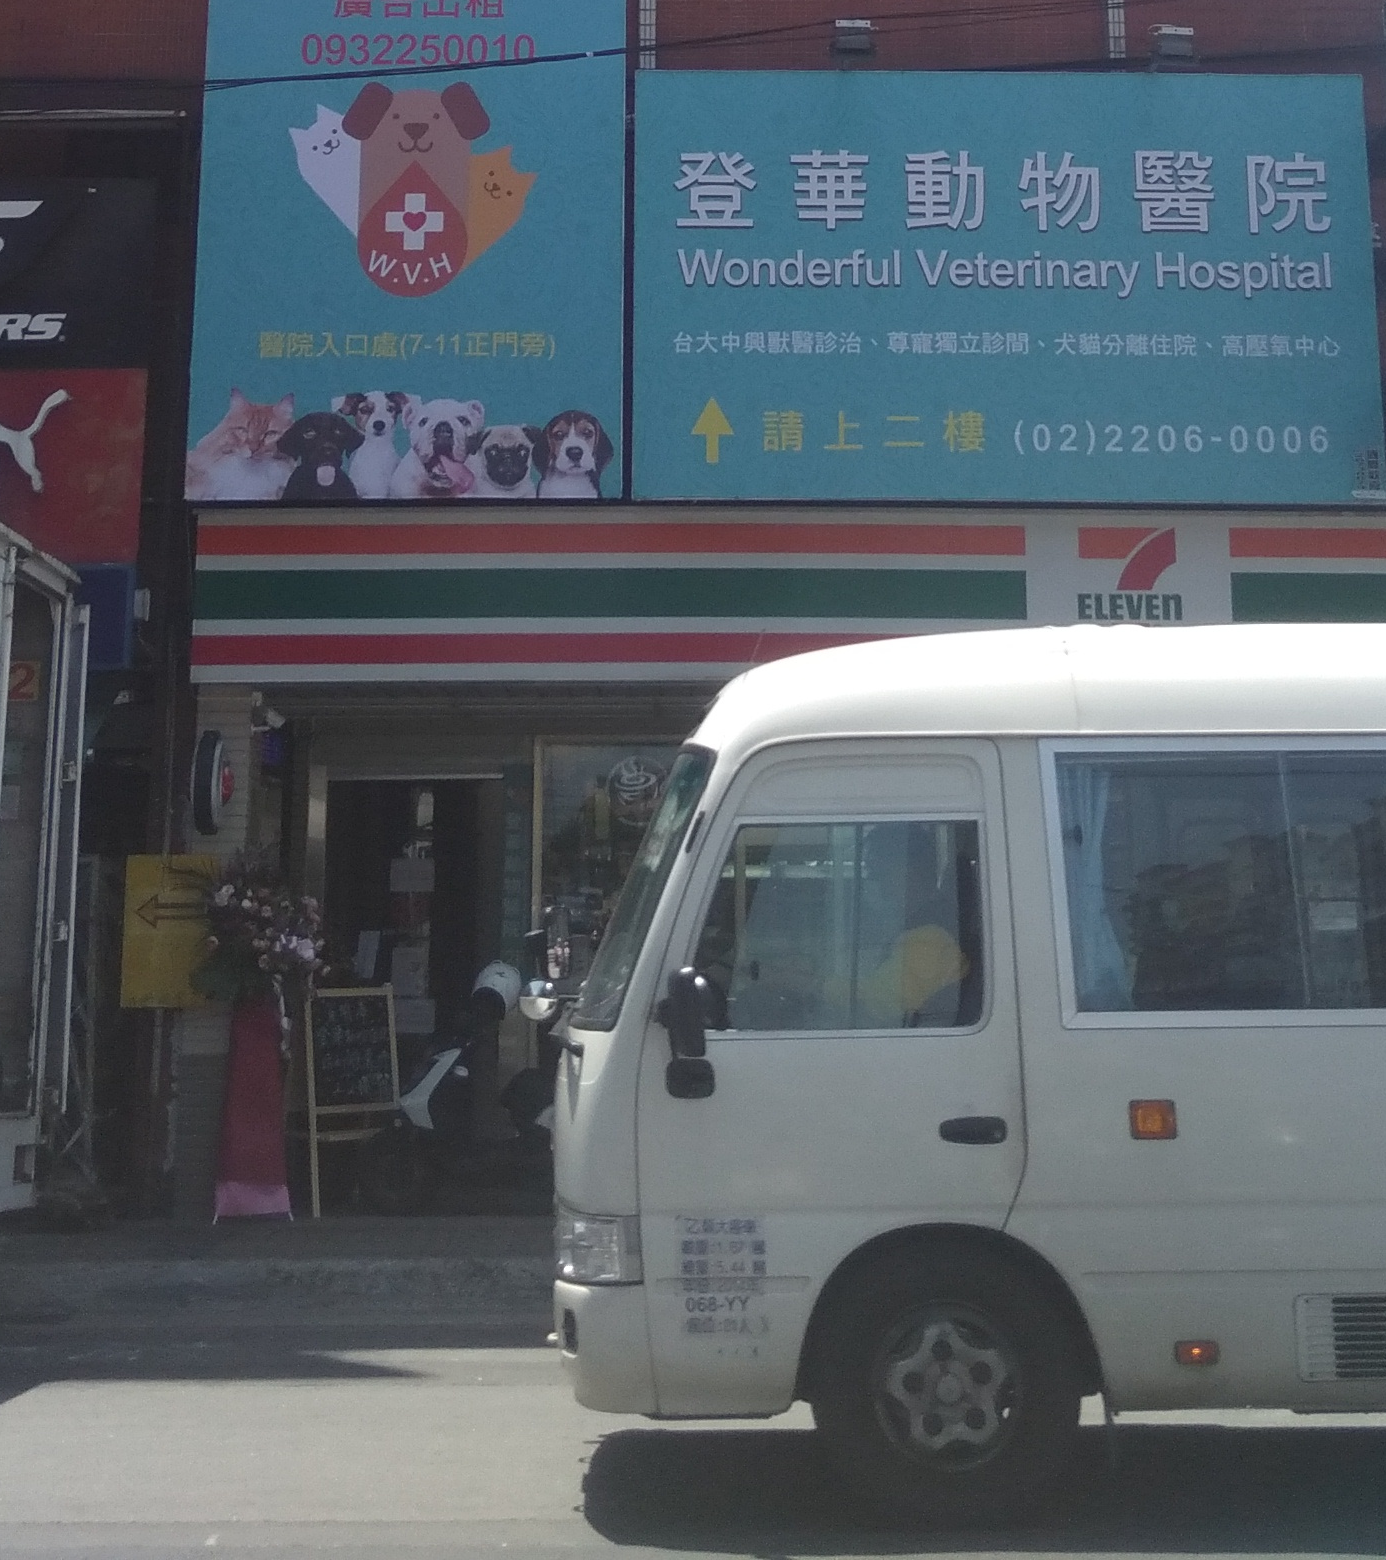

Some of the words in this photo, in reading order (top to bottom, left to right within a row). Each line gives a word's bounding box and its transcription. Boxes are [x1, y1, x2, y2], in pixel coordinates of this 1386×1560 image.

[301, 33, 536, 66] 0932250010
[673, 149, 1333, 236] 登華動物醫院
[677, 248, 903, 288] Wonderful
[916, 249, 1141, 299] Veterinary
[1155, 251, 1335, 299] Hospital
[762, 409, 986, 453] 請上二樓
[1013, 419, 1330, 456] (02)2206-0006
